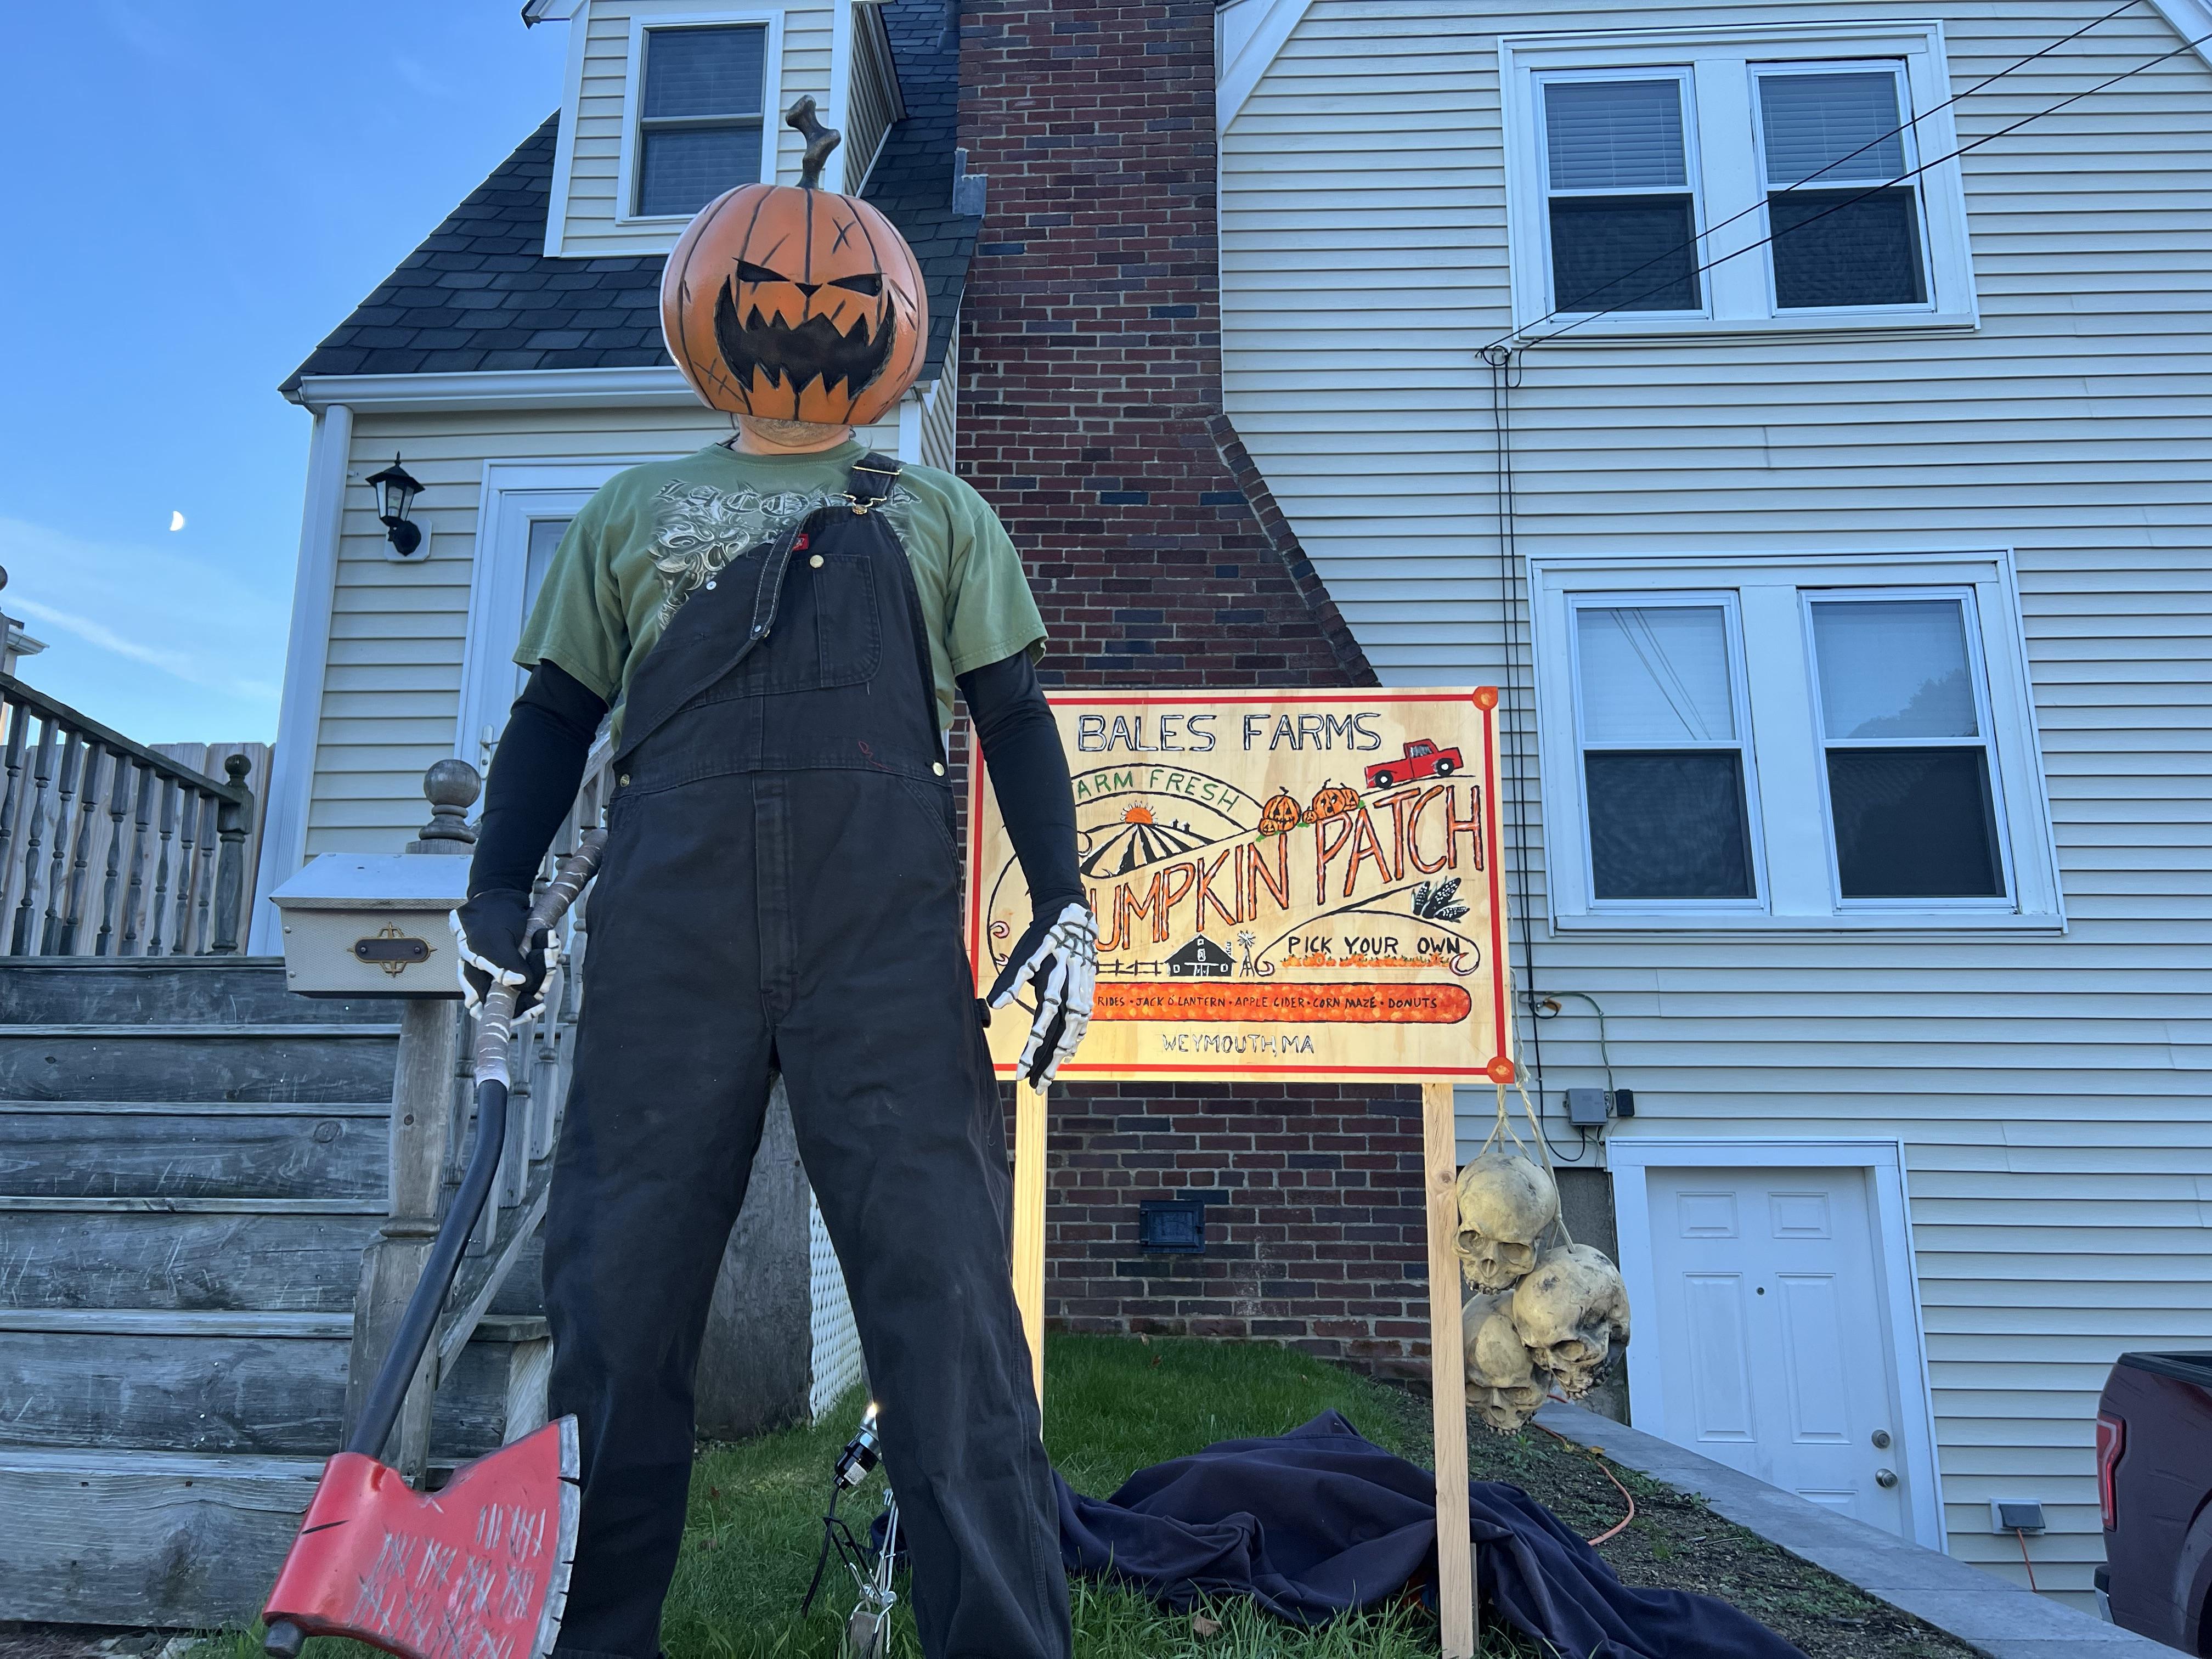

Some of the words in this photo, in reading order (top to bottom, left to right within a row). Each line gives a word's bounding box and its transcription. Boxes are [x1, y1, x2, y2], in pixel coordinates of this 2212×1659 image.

[1078, 715, 1217, 752] BALES
[1243, 713, 1381, 751] FARMS
[1077, 771, 1133, 799] ARM
[1149, 769, 1239, 812] FRESH
[1090, 833, 1289, 952] UMPKIN
[1316, 785, 1484, 906] PATCH
[1288, 936, 1333, 954] PICK
[1344, 936, 1399, 955] YOUR
[1417, 936, 1460, 955] OWN
[1097, 996, 1125, 1007] RIDES
[1136, 997, 1165, 1007] JACK
[1234, 997, 1268, 1007] APPLE
[1273, 997, 1305, 1008] CIDER
[1313, 997, 1340, 1008] CORN
[1345, 996, 1377, 1009] MAZE
[1388, 997, 1437, 1008] DONUTS
